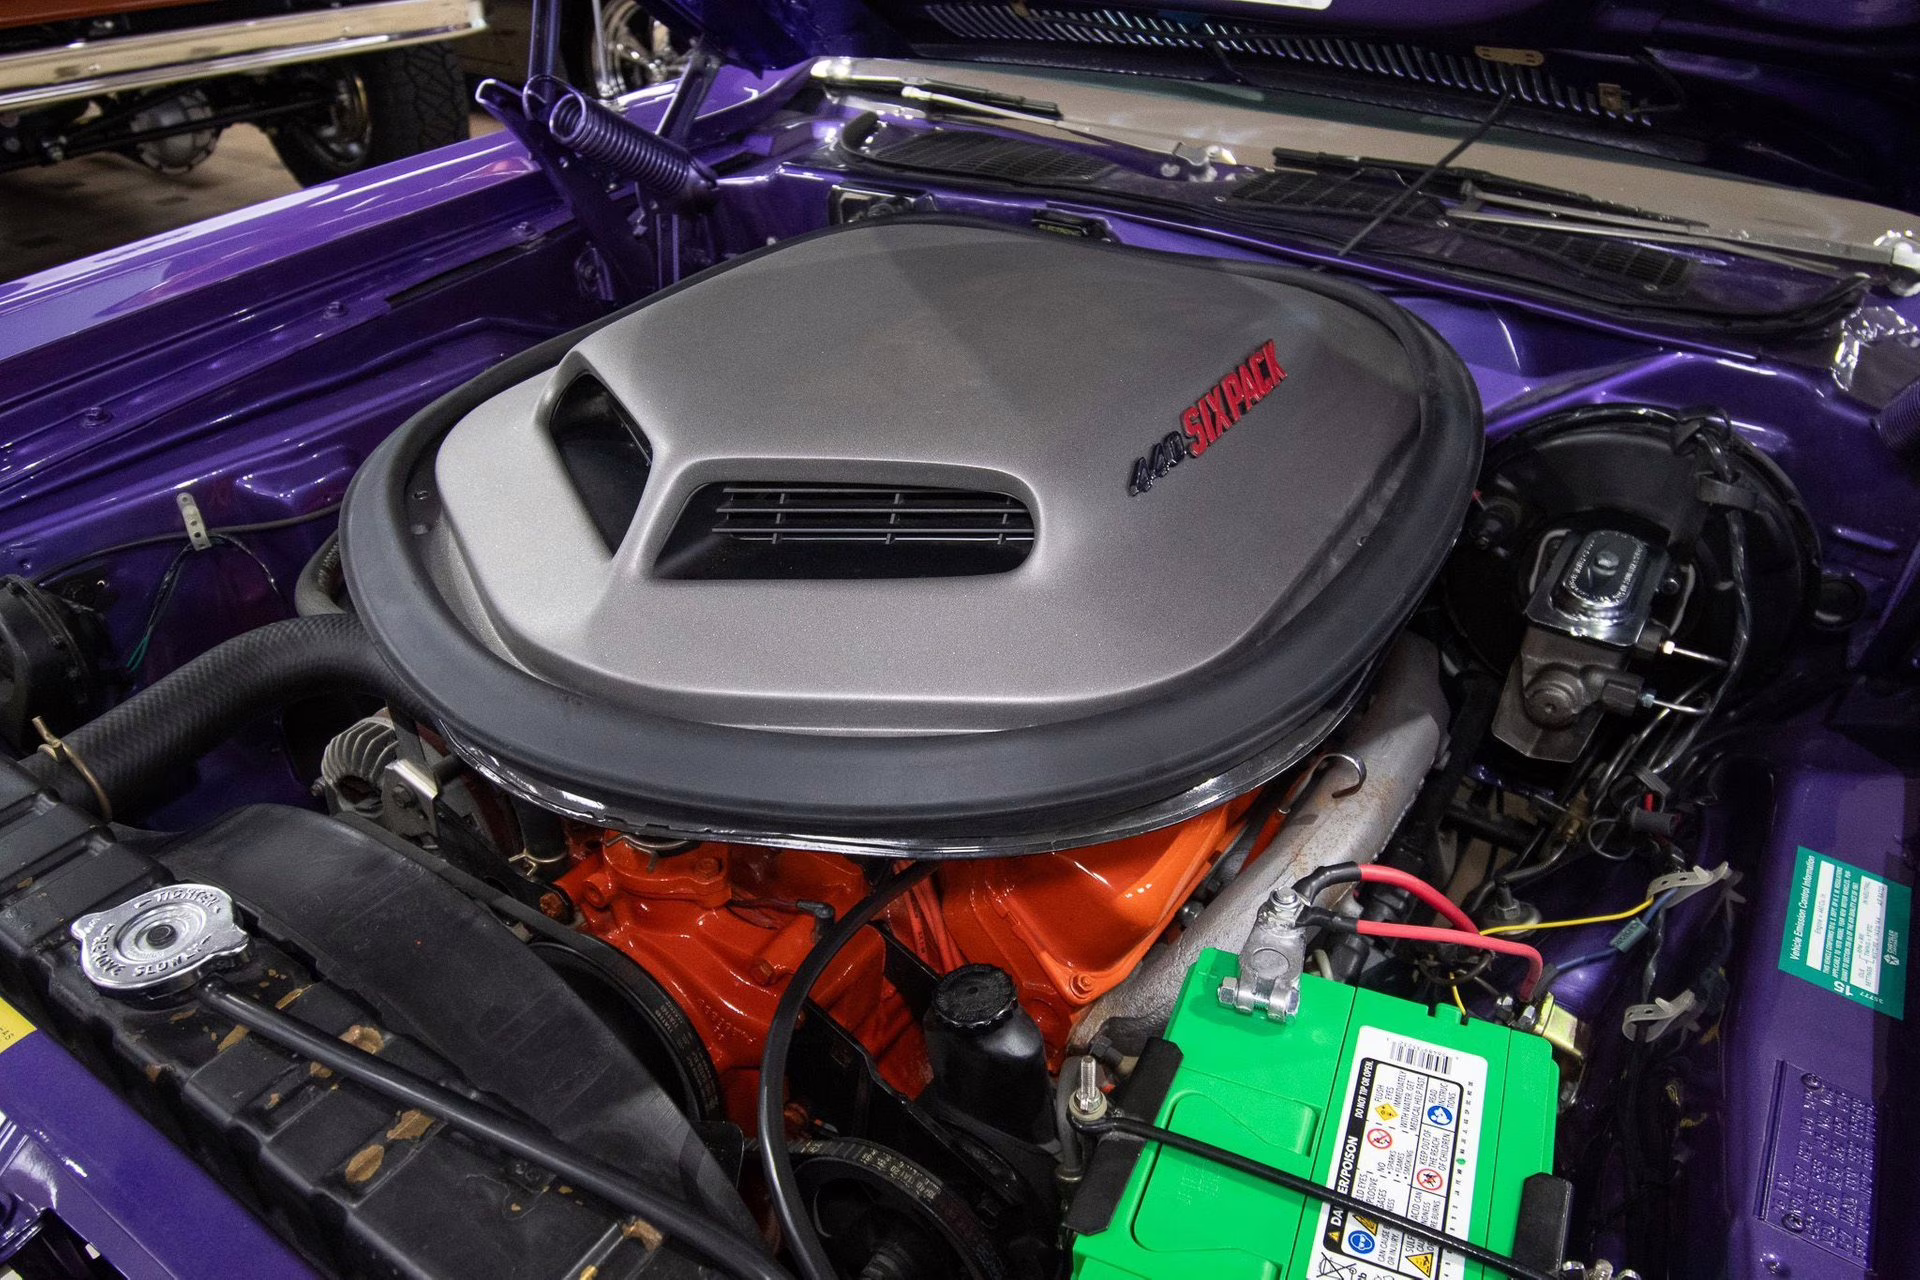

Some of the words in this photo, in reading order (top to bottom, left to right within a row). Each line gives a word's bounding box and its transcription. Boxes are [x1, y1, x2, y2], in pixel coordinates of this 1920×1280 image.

[1128, 431, 1186, 497] 440
[1803, 855, 1816, 887] Information
[1799, 889, 1810, 908] Control
[1793, 908, 1806, 936] Emission
[1789, 937, 1802, 961] Vehicle
[1831, 955, 1840, 978] APPLICABLE
[1836, 926, 1844, 940] MODEL
[1362, 1059, 1373, 1077] OPEN.
[1360, 1076, 1370, 1086] OR
[1392, 1070, 1406, 1108] IMMEDIATELY
[1359, 1085, 1368, 1096] TIP
[1374, 1083, 1384, 1102] FLUSH
[1384, 1085, 1394, 1100] EYES
[1413, 1089, 1423, 1105] HELP
[1428, 1088, 1437, 1104] READ
[1356, 1095, 1366, 1108] NOT
[1399, 1111, 1409, 1128] WITH
[1405, 1079, 1414, 1091] GET
[1354, 1107, 1363, 1118] DO
[1409, 1104, 1420, 1131] MEDICAL
[1423, 1129, 1431, 1137] OF
[1421, 1137, 1430, 1150] OUT
[1430, 1136, 1440, 1156] REACH
[1376, 1161, 1385, 1172] NO
[1386, 1149, 1396, 1171] SPARKS
[1394, 1151, 1404, 1173] FLAMES
[1419, 1149, 1428, 1166] KEEP
[1428, 1155, 1437, 1168] THE
[1437, 1161, 1446, 1171] OF
[1329, 1135, 1359, 1226] DAER/POISON
[1413, 1190, 1422, 1203] CAN
[1410, 1202, 1420, 1220] ACID
[1379, 1228, 1390, 1249] CAUSE
[1377, 1248, 1386, 1263] CAN
[1386, 1254, 1395, 1266] OR
